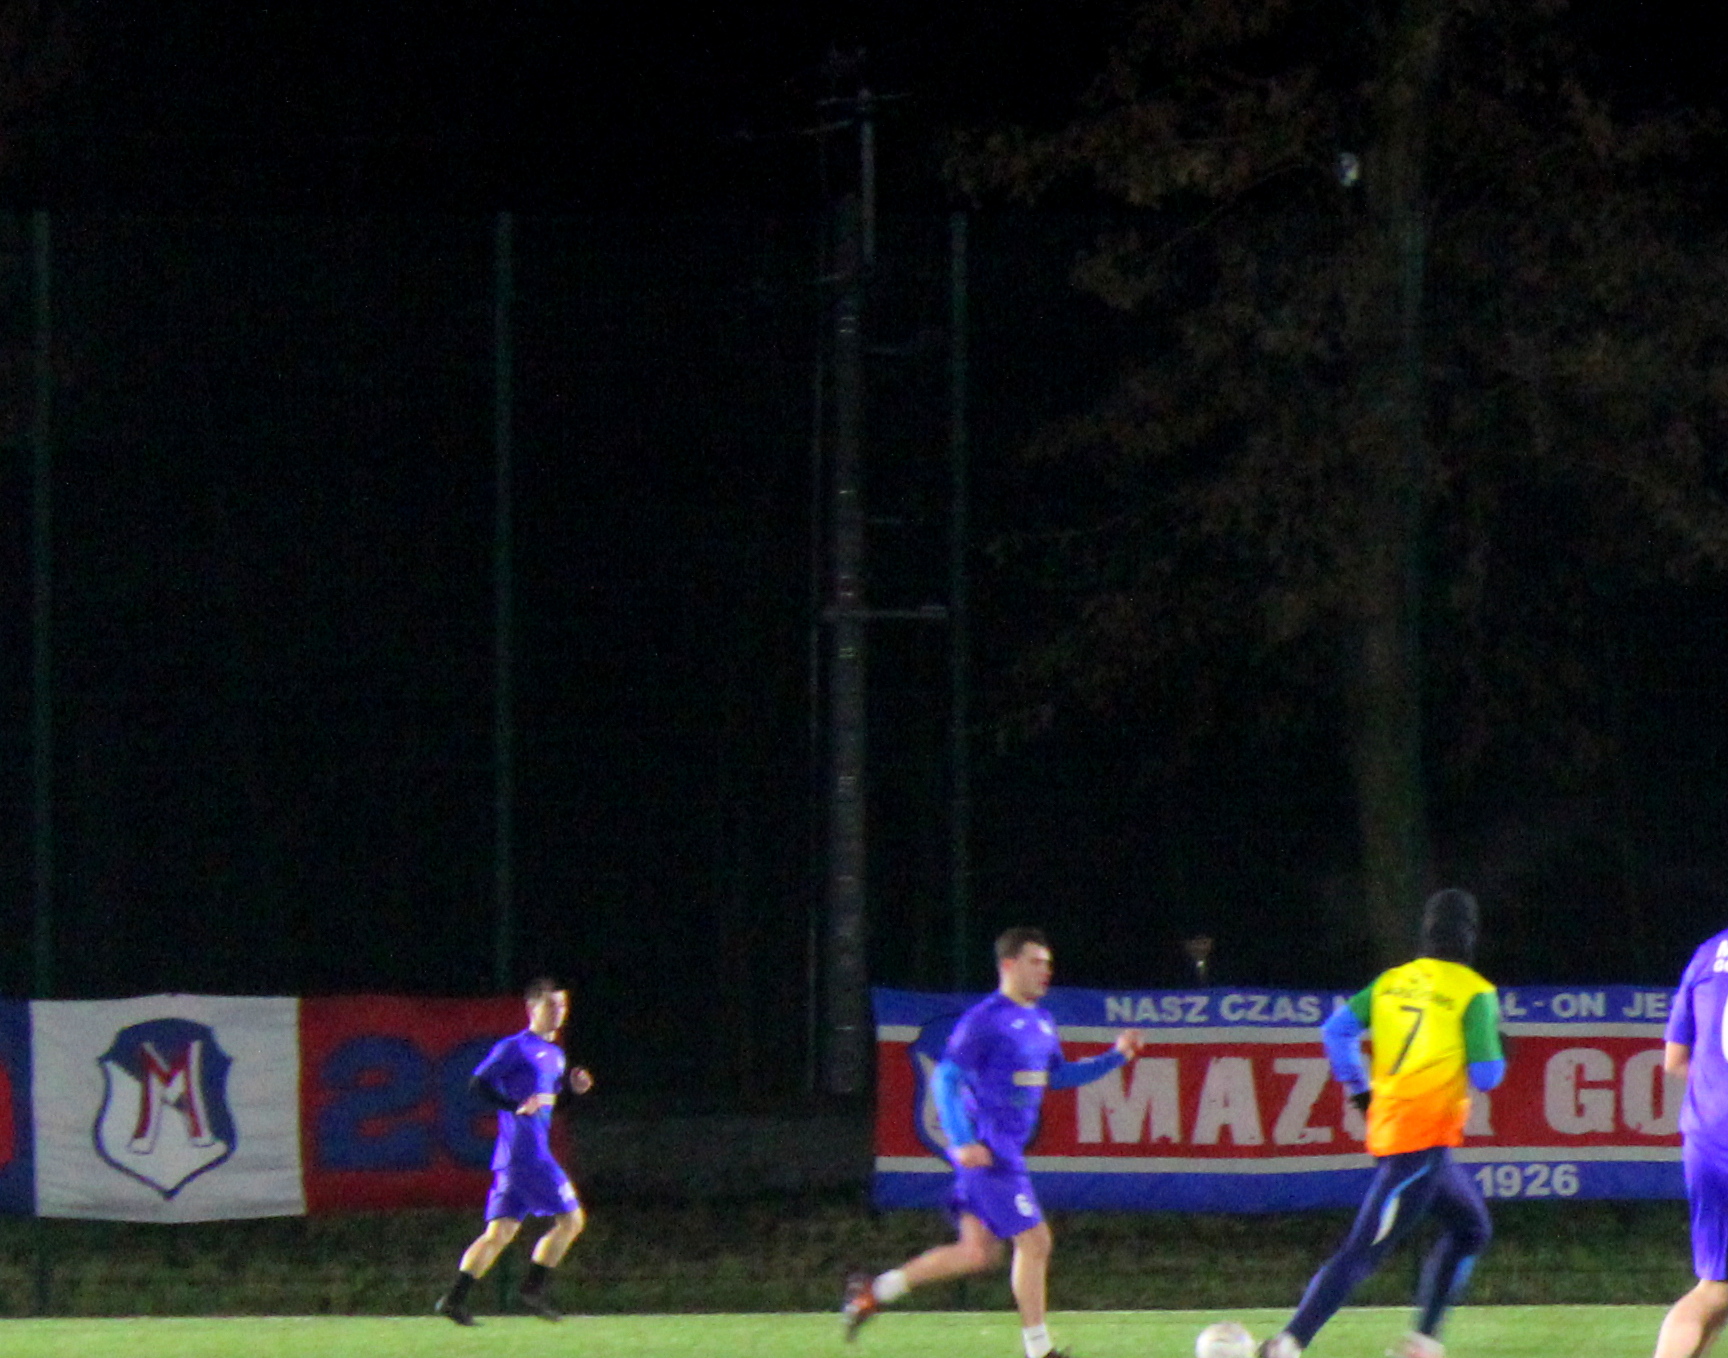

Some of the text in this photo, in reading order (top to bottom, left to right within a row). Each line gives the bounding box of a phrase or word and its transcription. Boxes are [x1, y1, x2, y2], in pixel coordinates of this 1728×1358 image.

[1105, 996, 1210, 1023] NASZ
[1219, 994, 1322, 1022] CZAS
[1551, 992, 1606, 1018] ON
[1388, 1004, 1426, 1077] 7
[1077, 1055, 1494, 1145] MAZ
[1475, 1162, 1579, 1198] 1926
